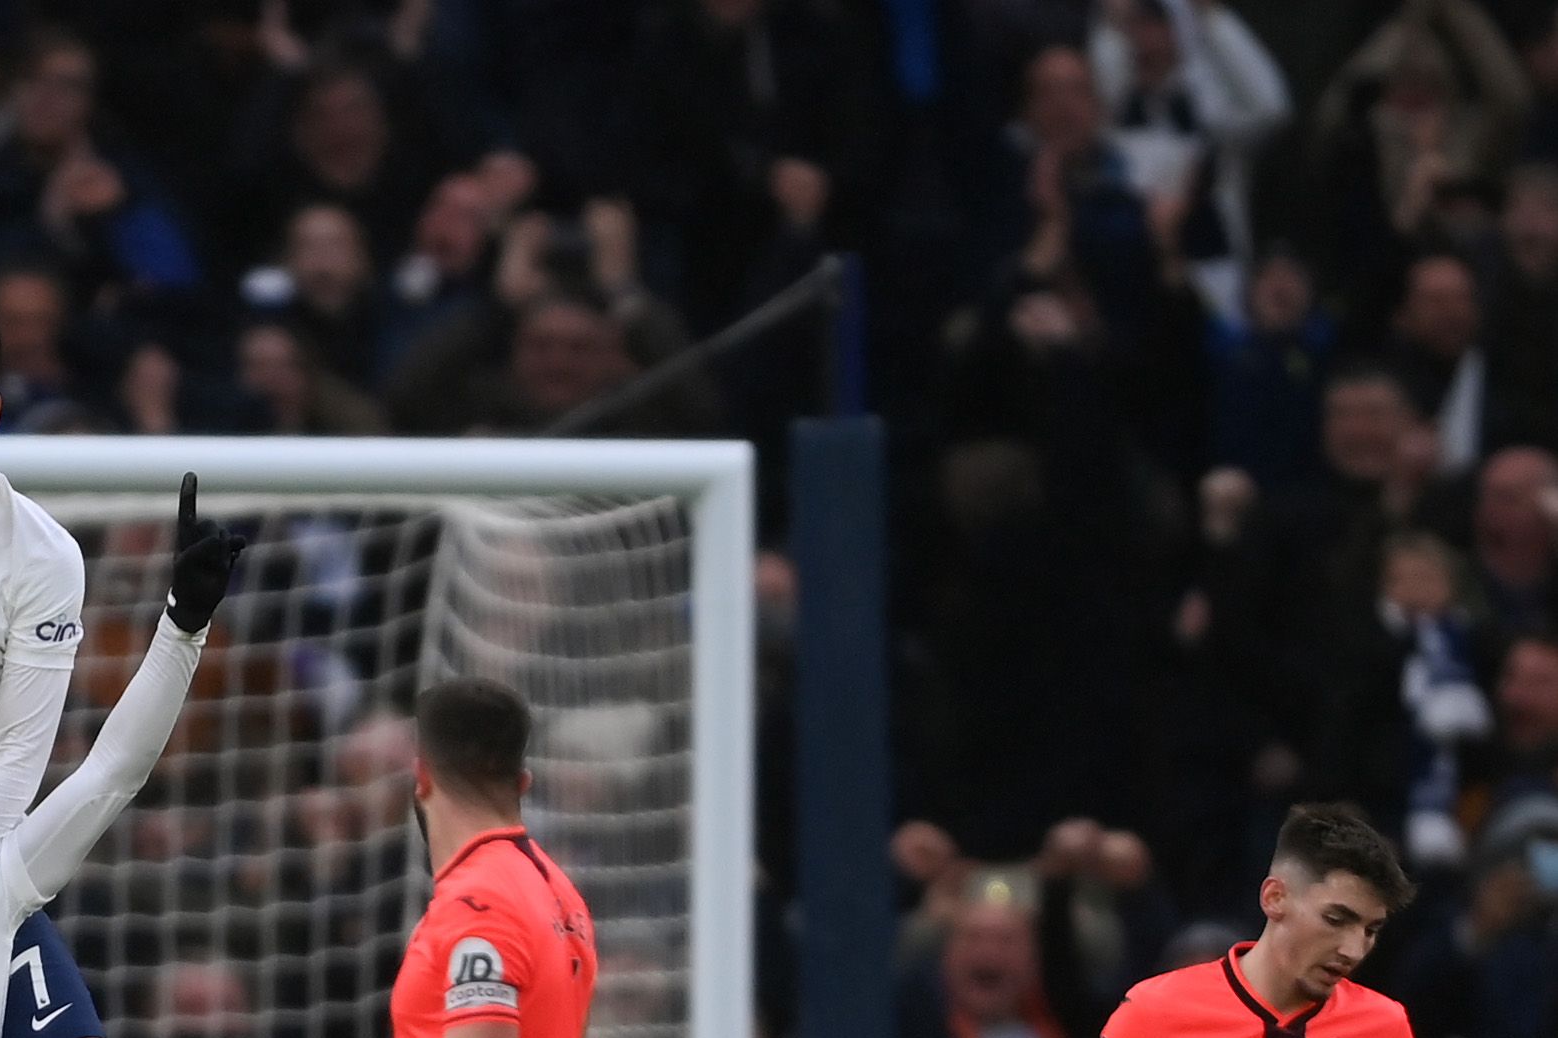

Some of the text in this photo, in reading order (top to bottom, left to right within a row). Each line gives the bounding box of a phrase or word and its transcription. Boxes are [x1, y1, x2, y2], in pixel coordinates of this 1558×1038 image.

[36, 621, 80, 642] cin
[9, 945, 50, 1010] 7
[455, 952, 493, 985] JD
